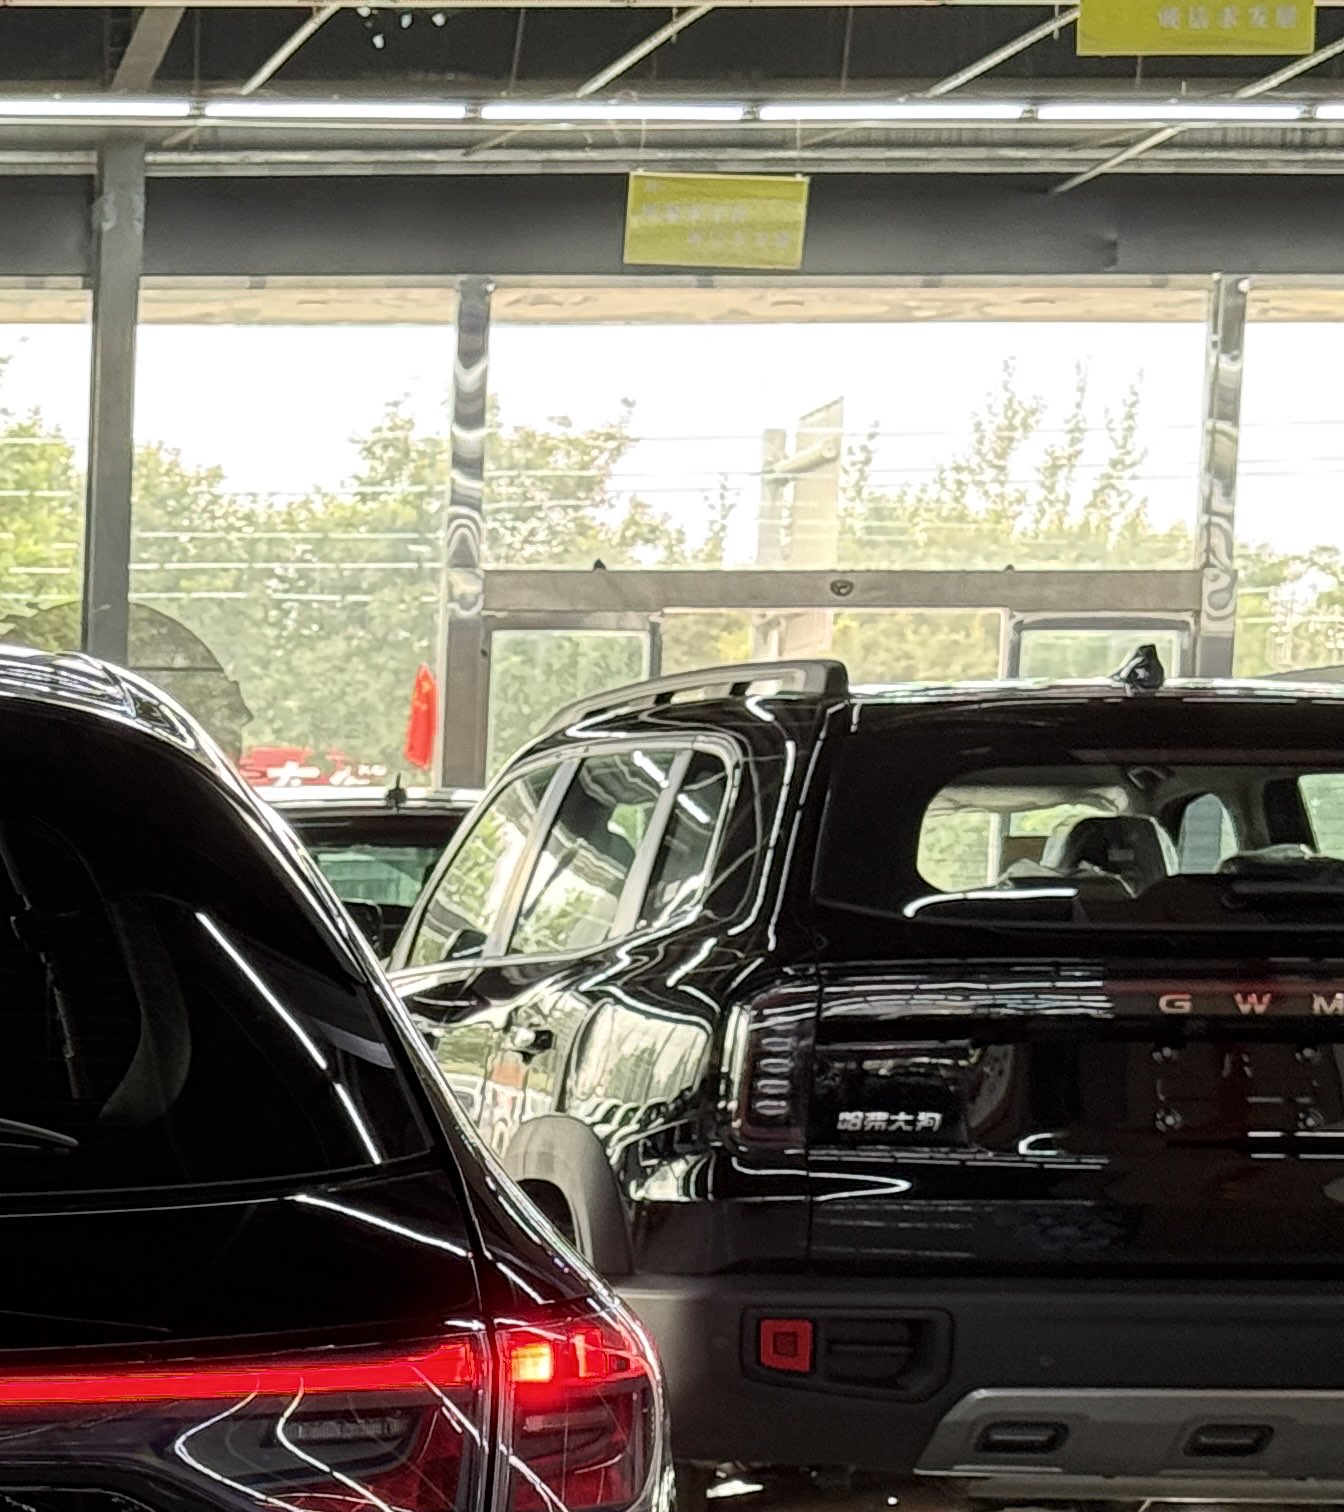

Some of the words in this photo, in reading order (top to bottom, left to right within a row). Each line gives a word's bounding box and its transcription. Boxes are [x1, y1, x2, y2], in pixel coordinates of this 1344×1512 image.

[1158, 992, 1344, 1016] GWM
[836, 1111, 943, 1132] 哈弗大狗
